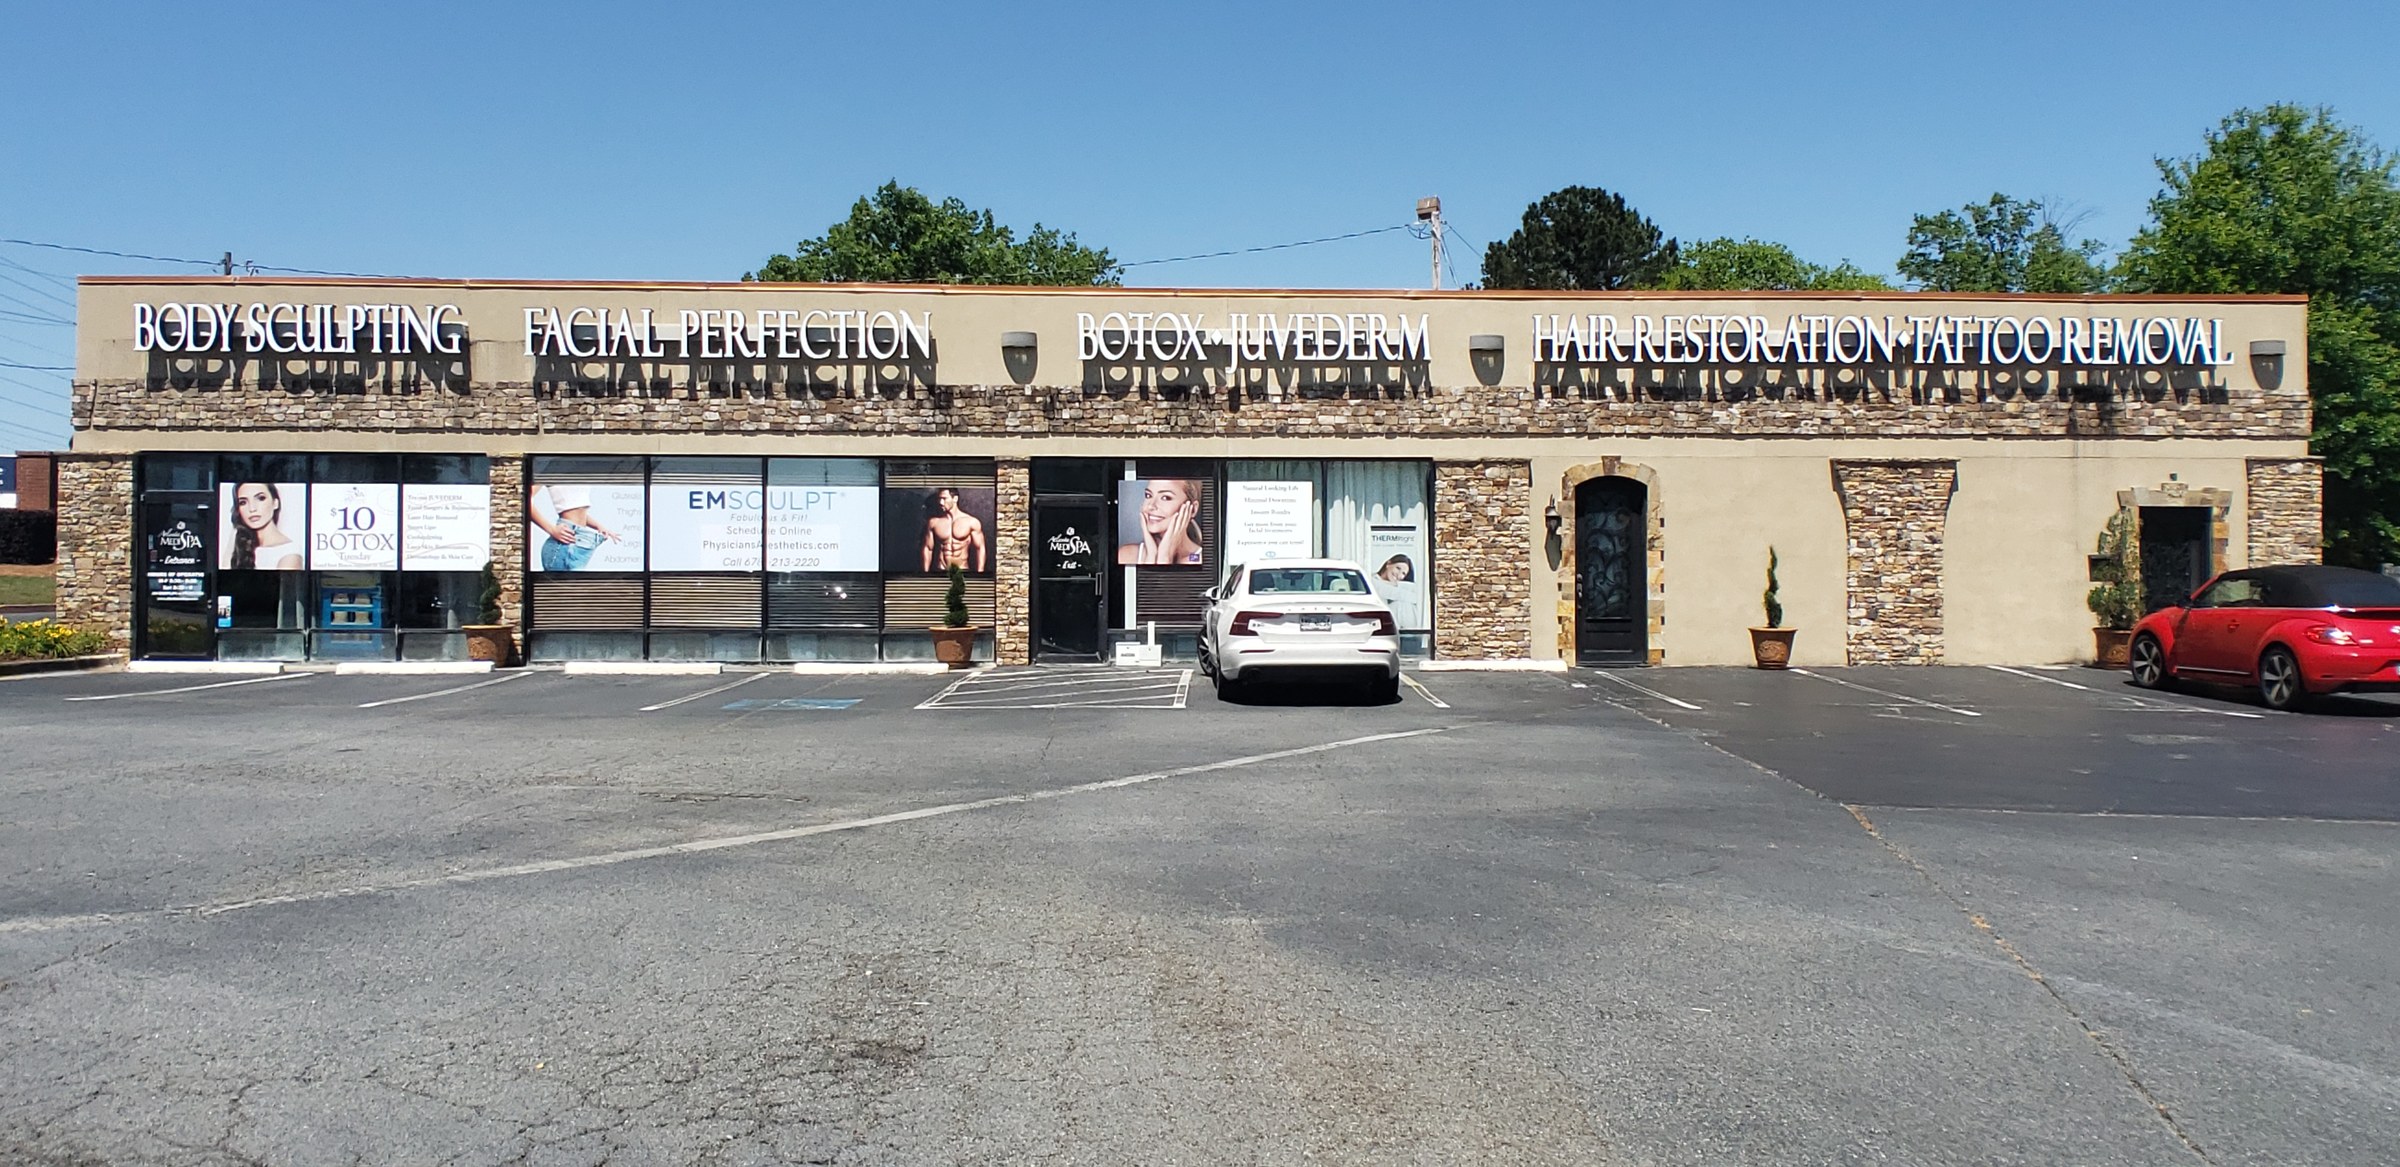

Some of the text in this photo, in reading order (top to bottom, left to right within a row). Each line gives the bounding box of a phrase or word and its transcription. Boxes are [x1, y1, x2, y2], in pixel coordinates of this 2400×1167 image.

[134, 302, 464, 354] BODY SCULPTING
[523, 307, 932, 360] FACIAL PERFECTION
[1077, 312, 1432, 373] BOTOX JUVEDERM
[1533, 314, 1894, 364] HAIR RESTORATION
[1907, 316, 2235, 365] TATTOO REMOVAL
[330, 506, 376, 531] $10
[689, 491, 837, 510] EMSCULPT
[316, 533, 395, 551] BOTOX
[779, 526, 812, 535] Online
[722, 557, 742, 567] Call
